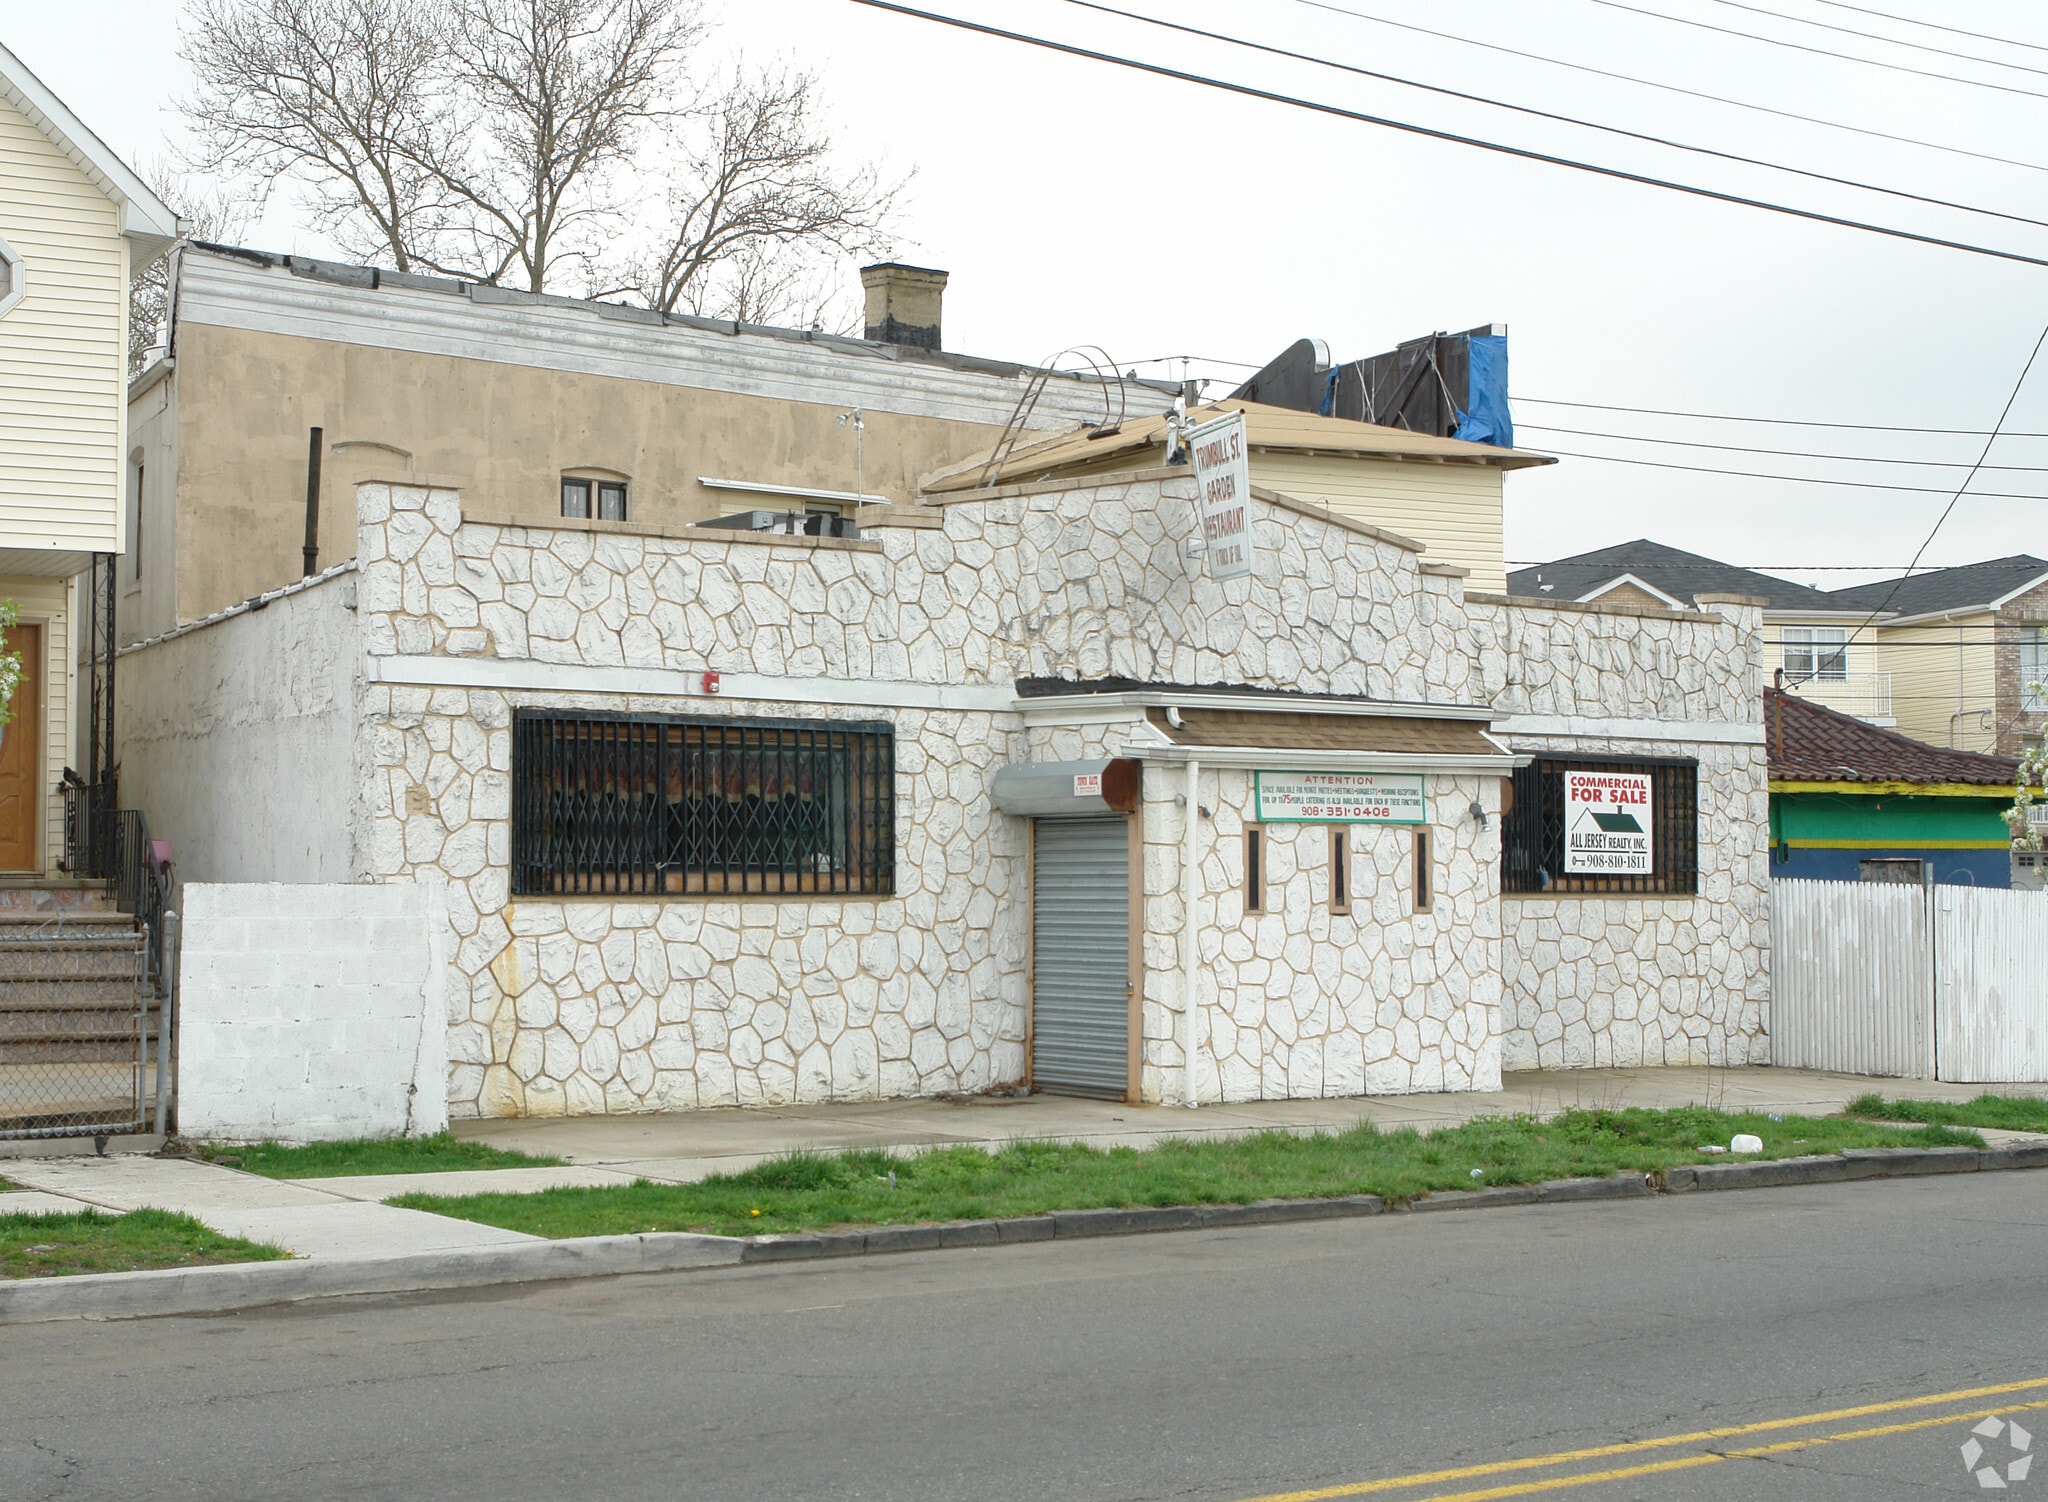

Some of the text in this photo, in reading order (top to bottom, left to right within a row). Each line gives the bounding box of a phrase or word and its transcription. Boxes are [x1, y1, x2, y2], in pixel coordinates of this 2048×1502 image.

[1206, 473, 1236, 505] GARDEN
[1204, 506, 1245, 540] RESTAURANT
[1304, 775, 1373, 785] ATTENTION
[1570, 776, 1647, 789] COMMERCIAL
[1571, 788, 1647, 804] FOR SALE
[1570, 833, 1583, 848] ALL
[1584, 833, 1607, 849] JERSEY
